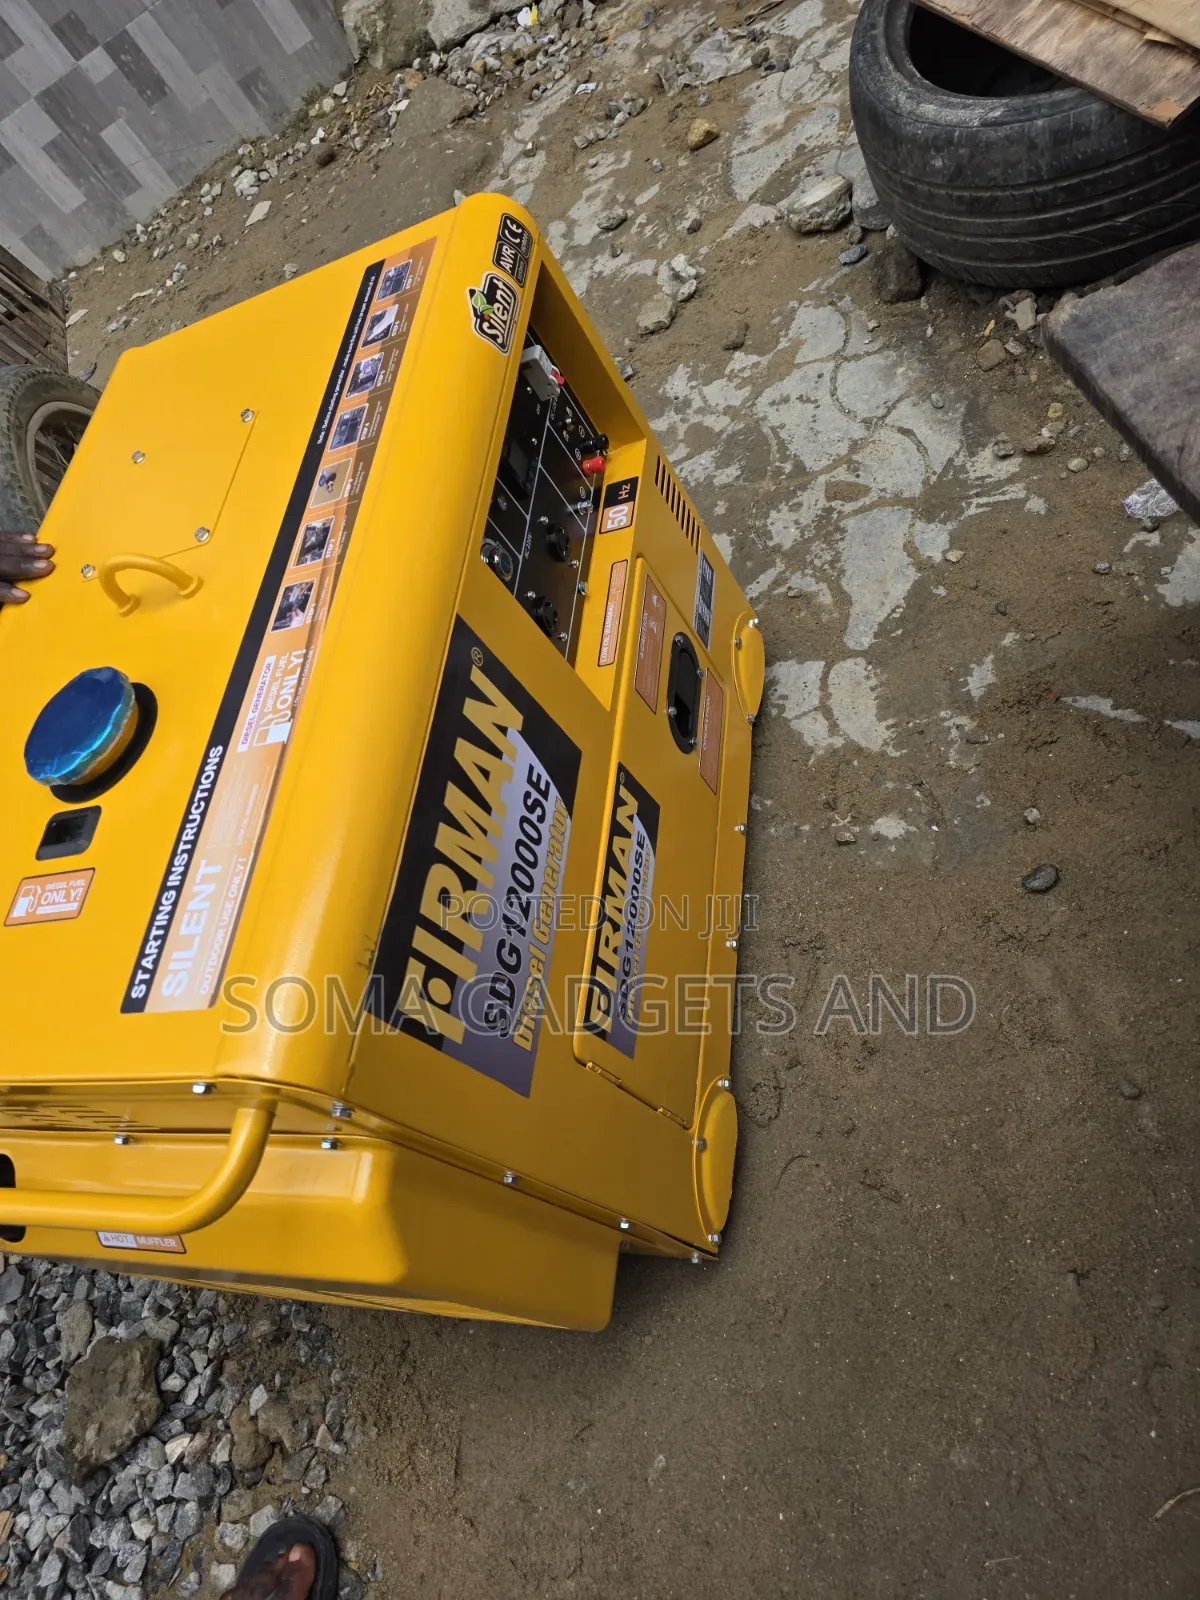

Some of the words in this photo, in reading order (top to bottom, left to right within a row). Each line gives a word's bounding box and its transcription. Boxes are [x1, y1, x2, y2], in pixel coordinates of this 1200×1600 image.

[500, 245, 515, 273] AVR
[483, 278, 512, 344] Silent
[607, 505, 629, 529] 50
[618, 483, 631, 499] Hz
[241, 713, 256, 744] DIESEL
[252, 662, 272, 714] GENERATOR
[264, 678, 281, 712] DIESEL
[276, 652, 290, 677] FUEL
[277, 649, 307, 709] ONLY!
[45, 881, 68, 891] DIESEL
[69, 879, 86, 887] FUEL
[131, 891, 176, 999] STARTING
[167, 745, 223, 886] INSTRUCTIONS
[398, 664, 523, 1044] FIRMAN
[41, 887, 83, 905] ONLY!
[162, 859, 223, 998] SILENT
[484, 763, 551, 1037] SDG12000SE
[513, 942, 548, 1051] Diesel
[532, 796, 568, 945] Generator
[199, 928, 228, 995] OUTDOOR
[222, 899, 234, 928] USE
